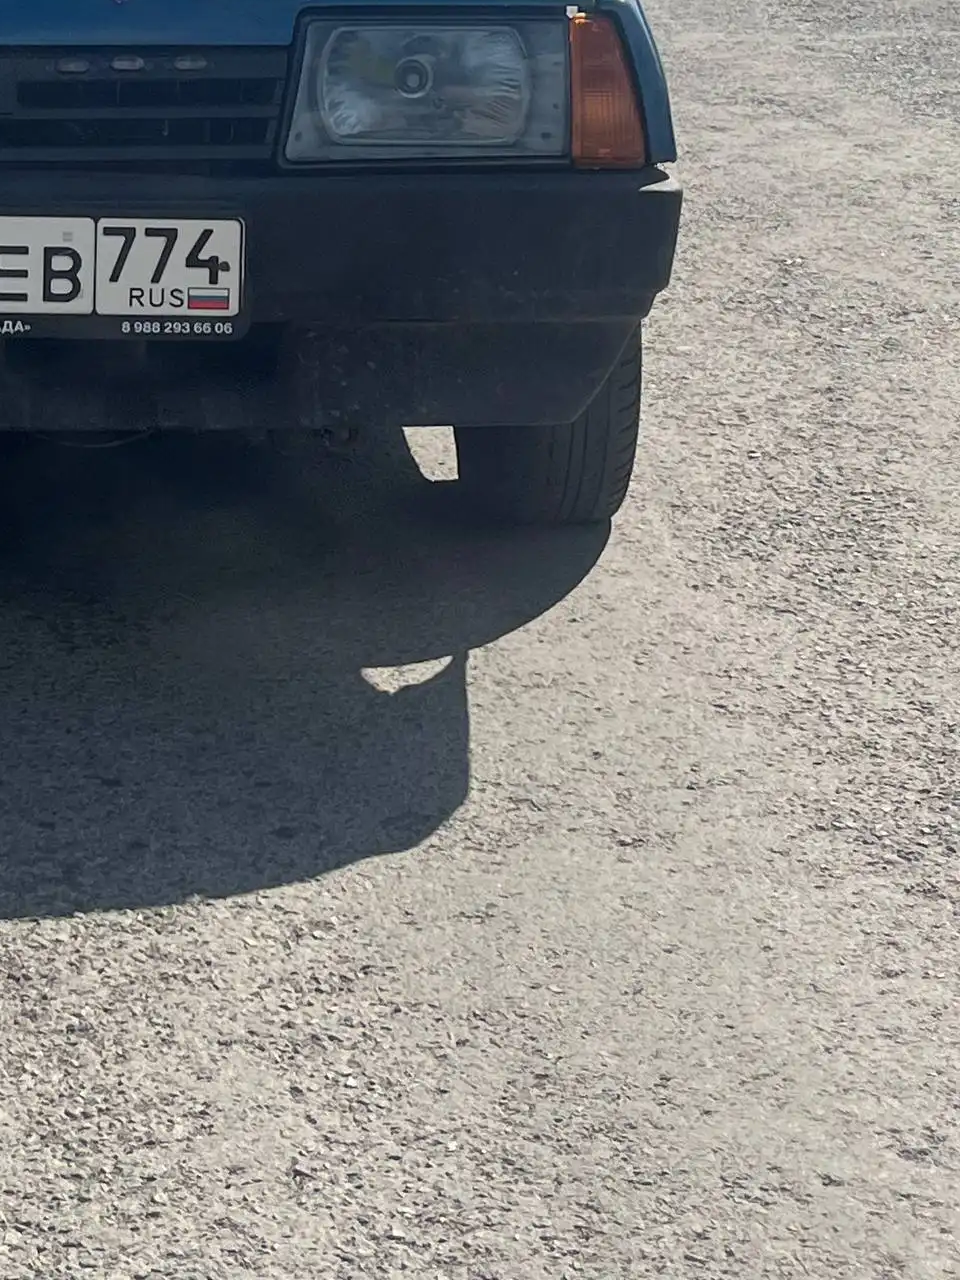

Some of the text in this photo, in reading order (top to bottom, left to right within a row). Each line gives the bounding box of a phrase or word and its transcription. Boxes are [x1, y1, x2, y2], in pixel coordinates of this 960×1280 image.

[102, 226, 219, 285] 774
[128, 287, 185, 308] RUS
[121, 322, 130, 333] 8
[163, 322, 191, 334] 293
[193, 323, 212, 334] 66
[214, 323, 233, 334] 06
